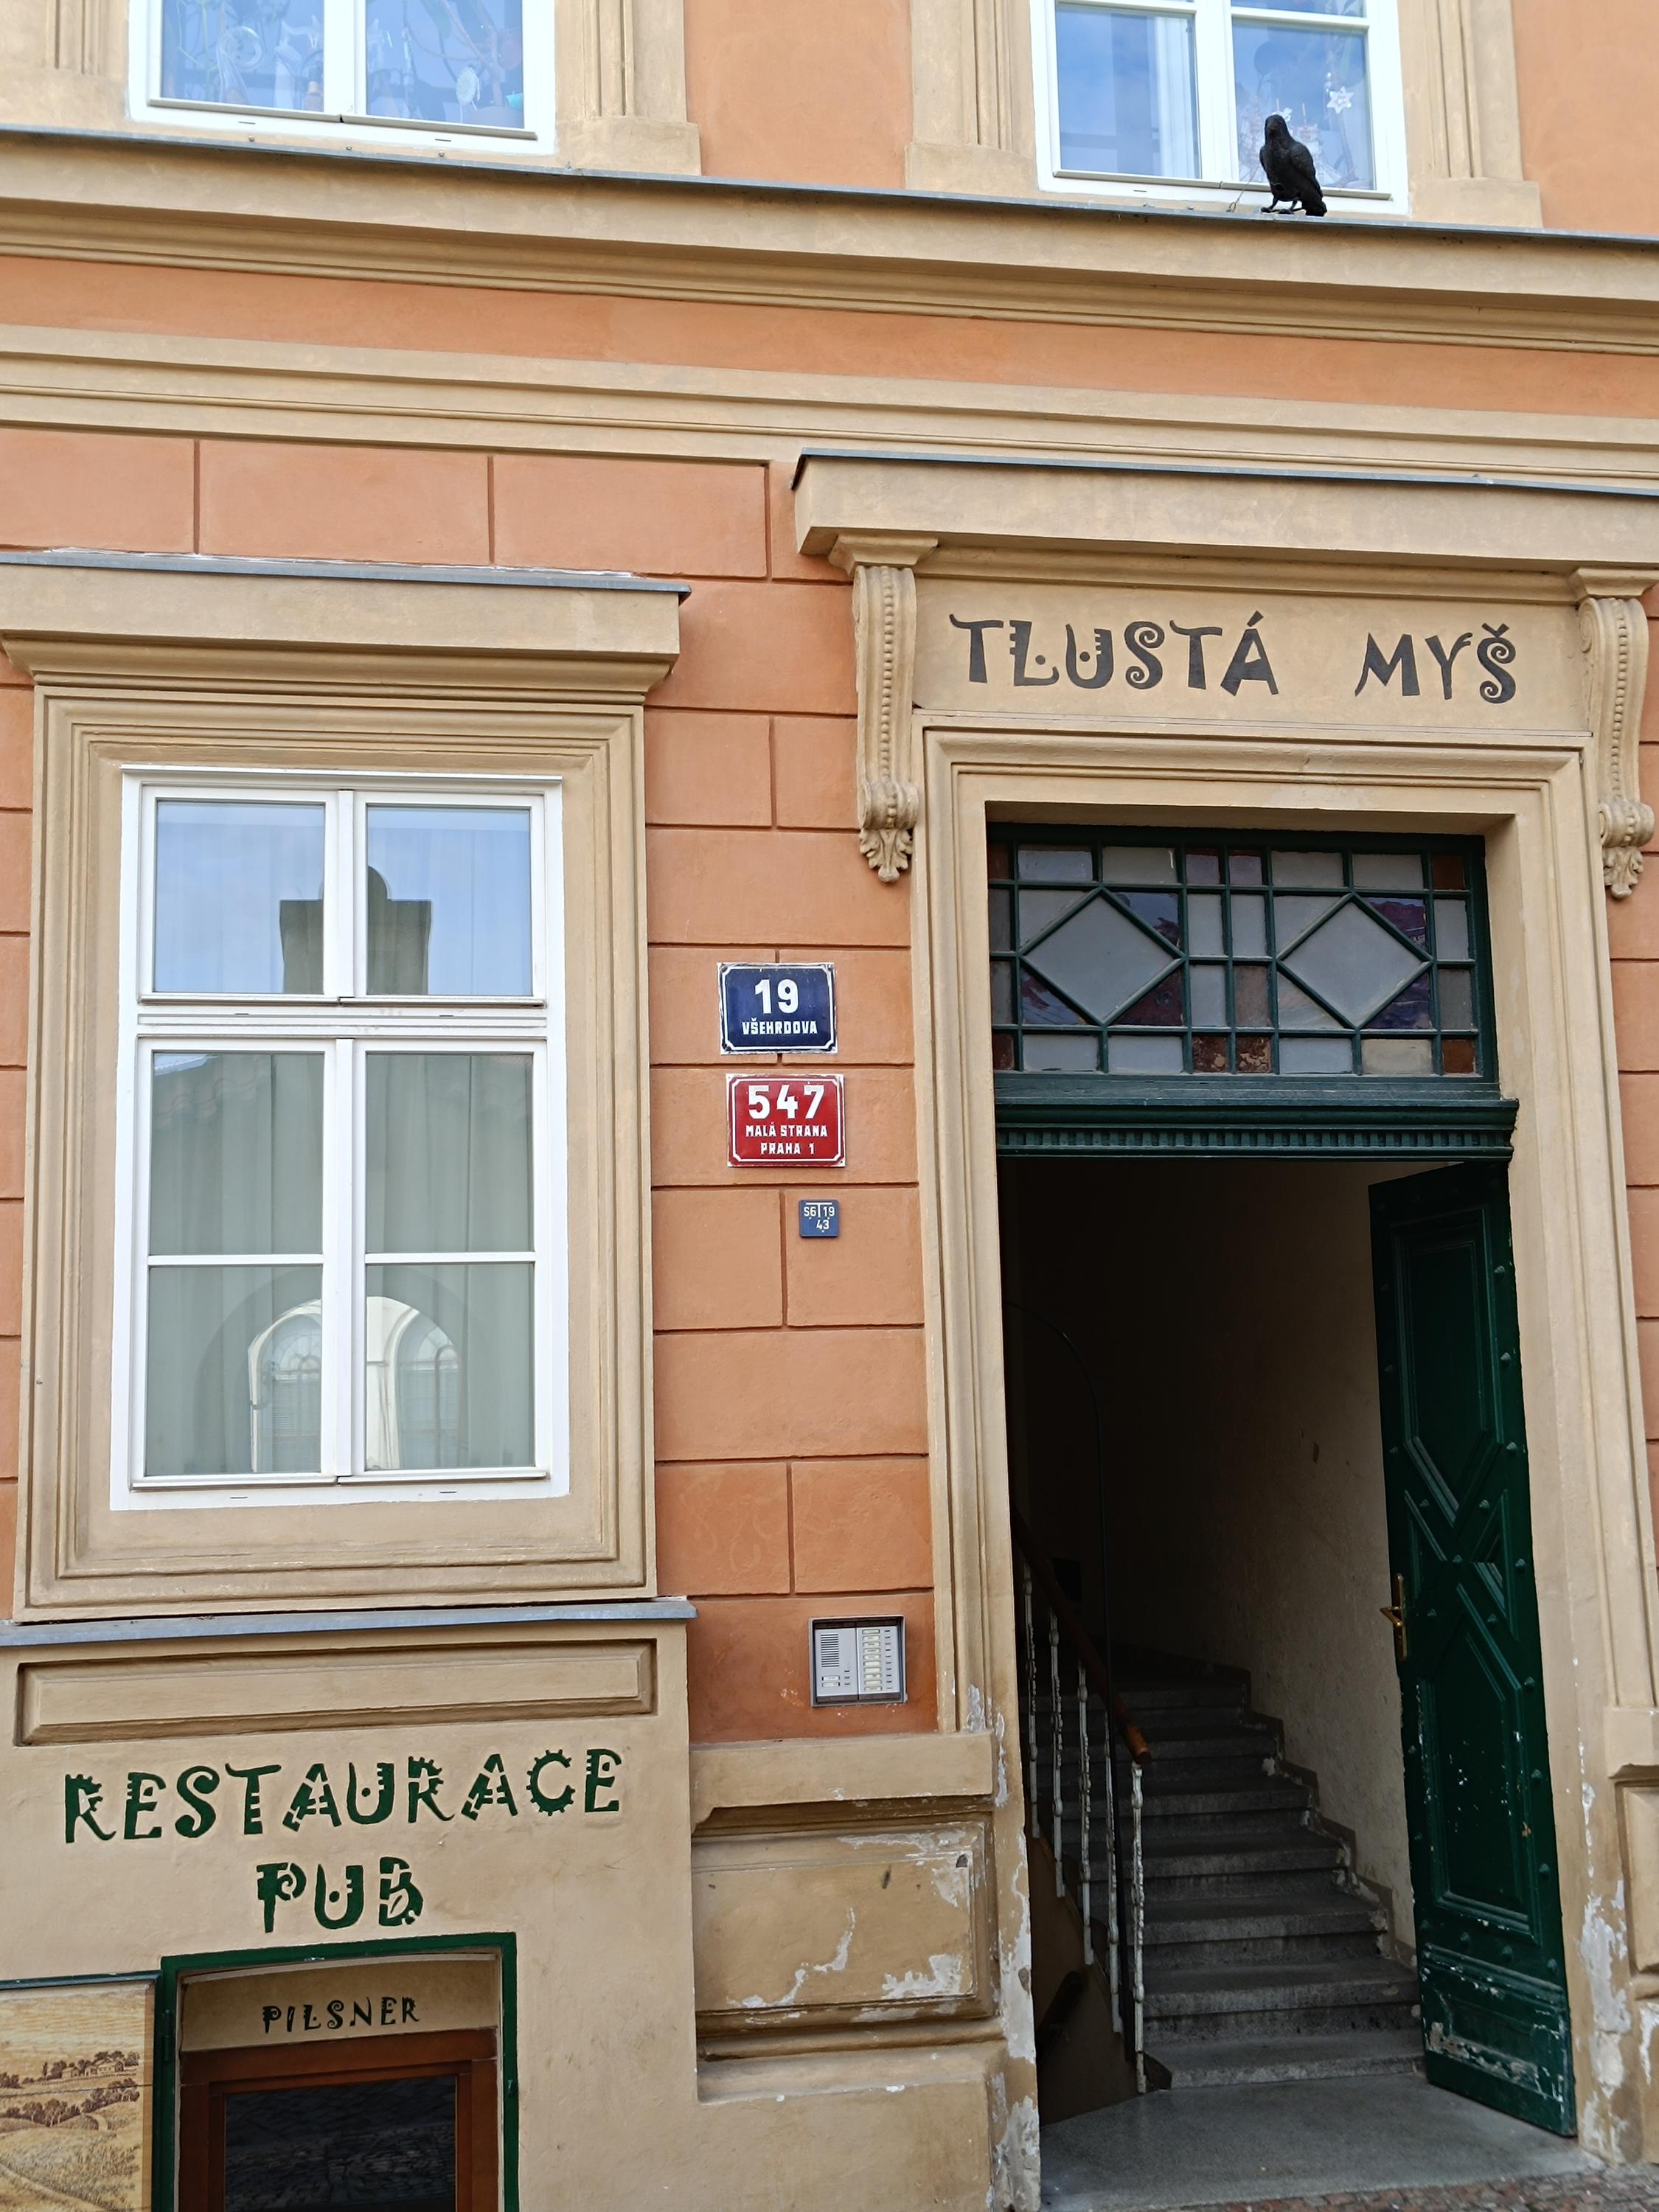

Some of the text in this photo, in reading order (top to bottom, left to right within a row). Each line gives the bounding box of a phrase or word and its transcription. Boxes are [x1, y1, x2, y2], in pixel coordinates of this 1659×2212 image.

[949, 611, 1517, 704] TLUSTÁ MYŠ
[755, 978, 799, 1014] 19
[742, 1018, 818, 1035] VŠEHRDOVA
[748, 1085, 825, 1119] 547
[745, 1121, 827, 1137] MALÁ STRANA
[760, 1142, 815, 1155] PRAHA 1
[64, 1748, 622, 1843] RESTAURACE
[257, 1857, 423, 1933] PUB
[262, 1996, 420, 2034] PILSNER
